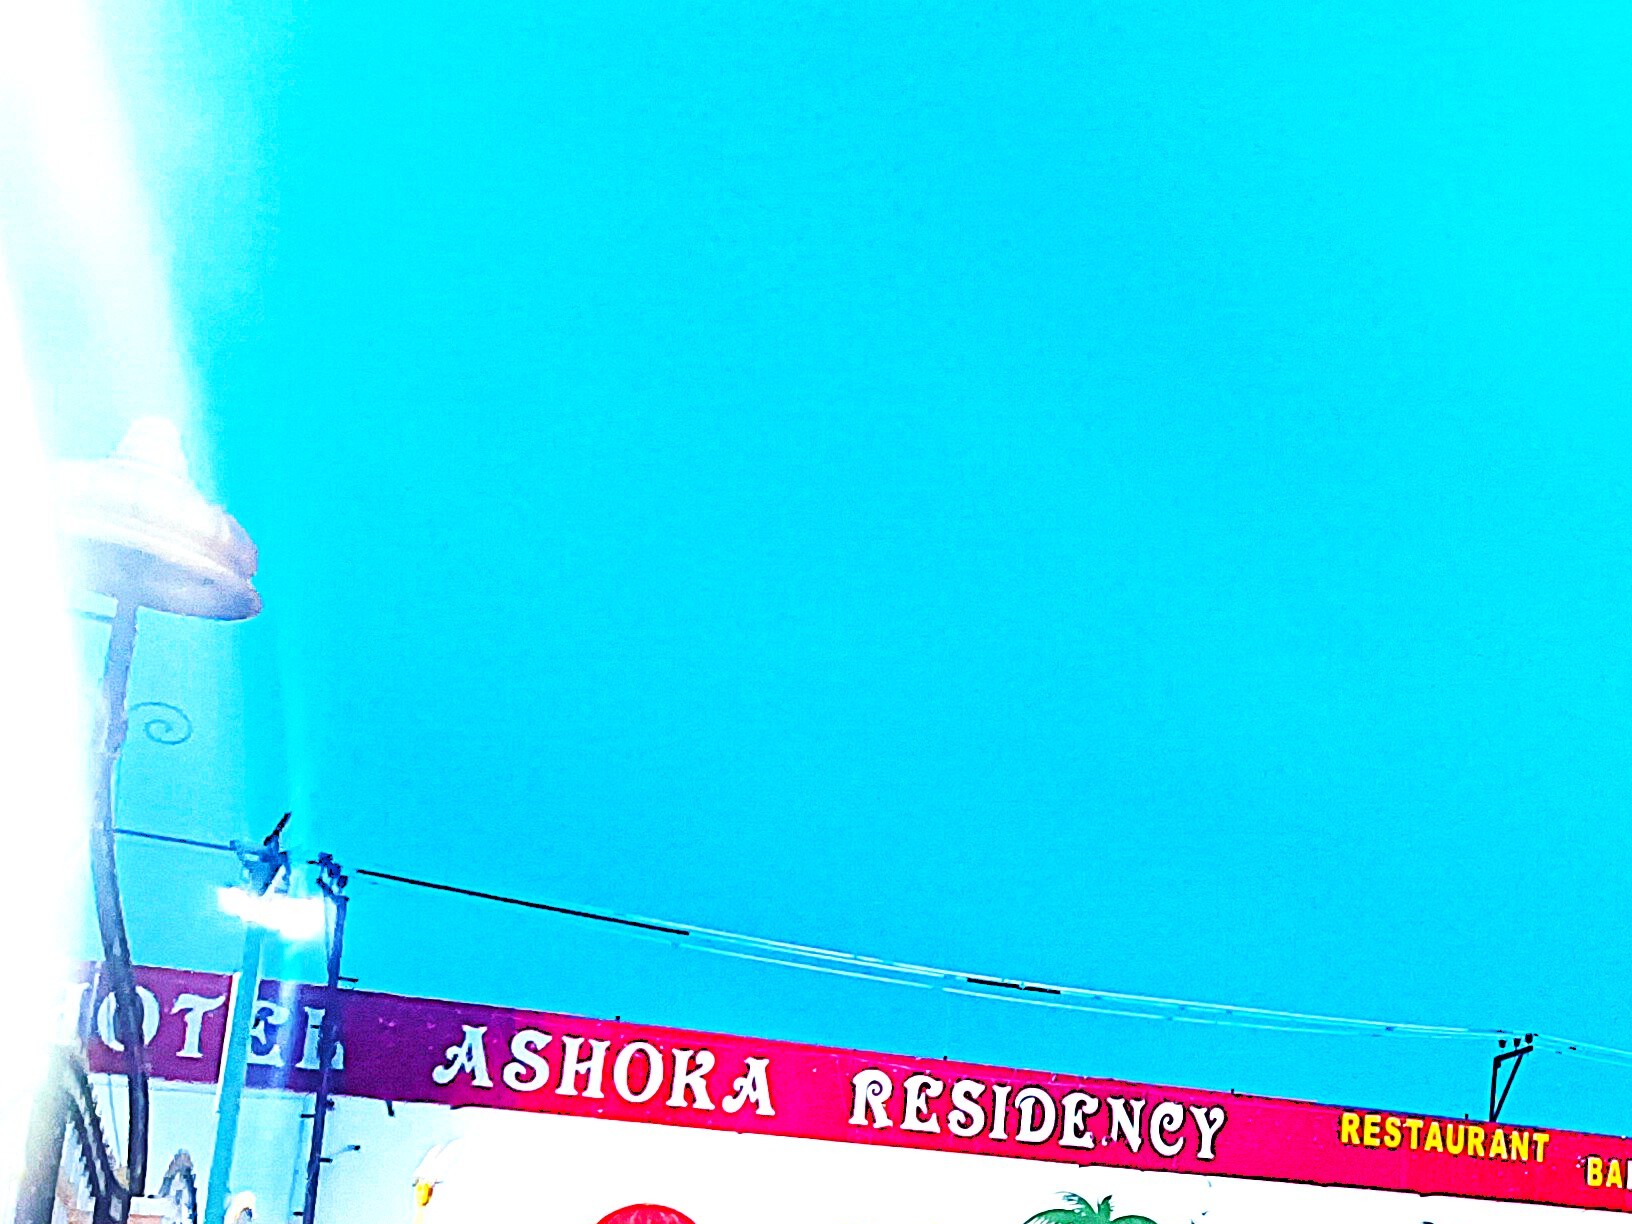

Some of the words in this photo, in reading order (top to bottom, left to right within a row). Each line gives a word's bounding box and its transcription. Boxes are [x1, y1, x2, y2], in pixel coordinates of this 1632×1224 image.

[431, 1024, 776, 1117] ASHOKA
[847, 1067, 1227, 1161] RESIDENCY
[1339, 1111, 1551, 1164] RESTAURANT
